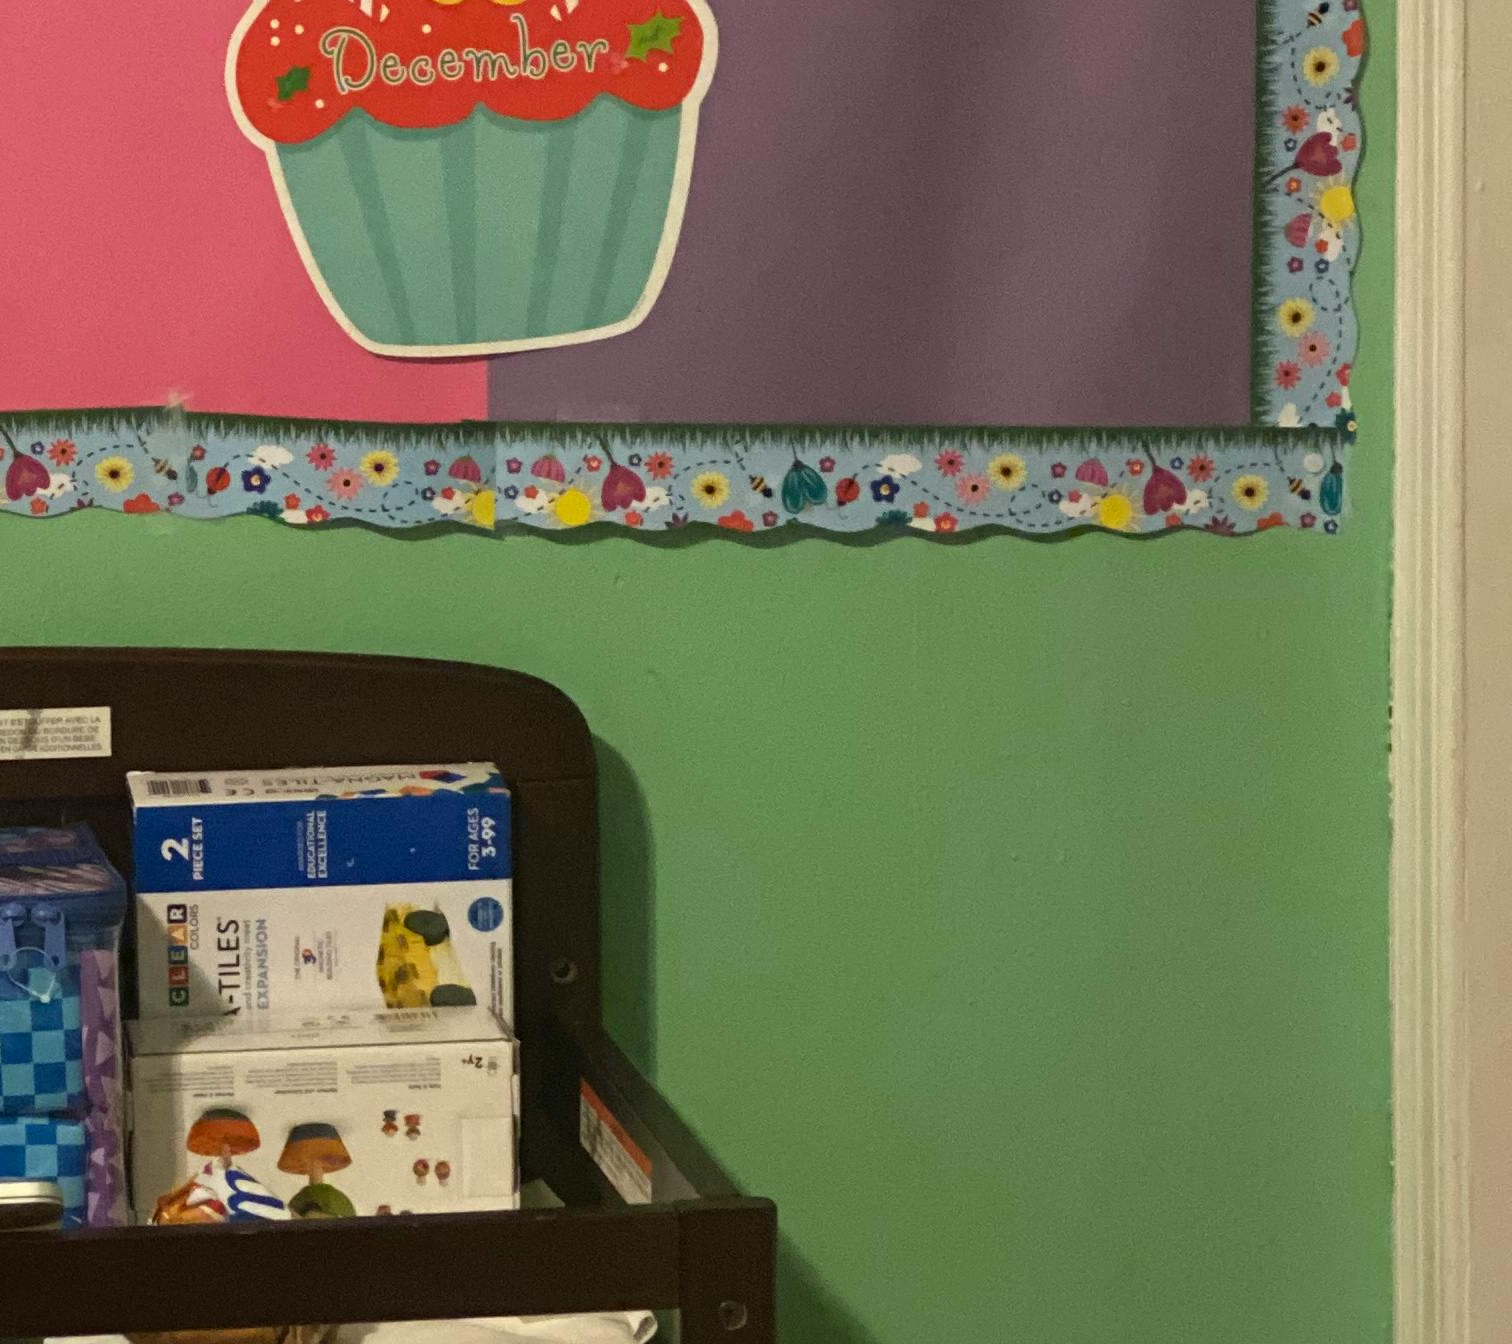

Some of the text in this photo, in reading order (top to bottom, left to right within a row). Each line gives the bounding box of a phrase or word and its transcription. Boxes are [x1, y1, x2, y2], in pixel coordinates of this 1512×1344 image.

[319, 13, 608, 95] December
[161, 838, 190, 861] 2
[192, 817, 204, 880] PIECE SET
[306, 810, 317, 879] EDUCATIONAL
[317, 810, 328, 879] EXCELLENCE
[467, 808, 480, 871] FOR AGES
[481, 816, 496, 858] 3-99
[168, 905, 188, 1005] CLEAR
[189, 904, 200, 951] COLORS
[255, 919, 269, 1010] EXPANSION
[461, 1055, 484, 1069] 2y+
